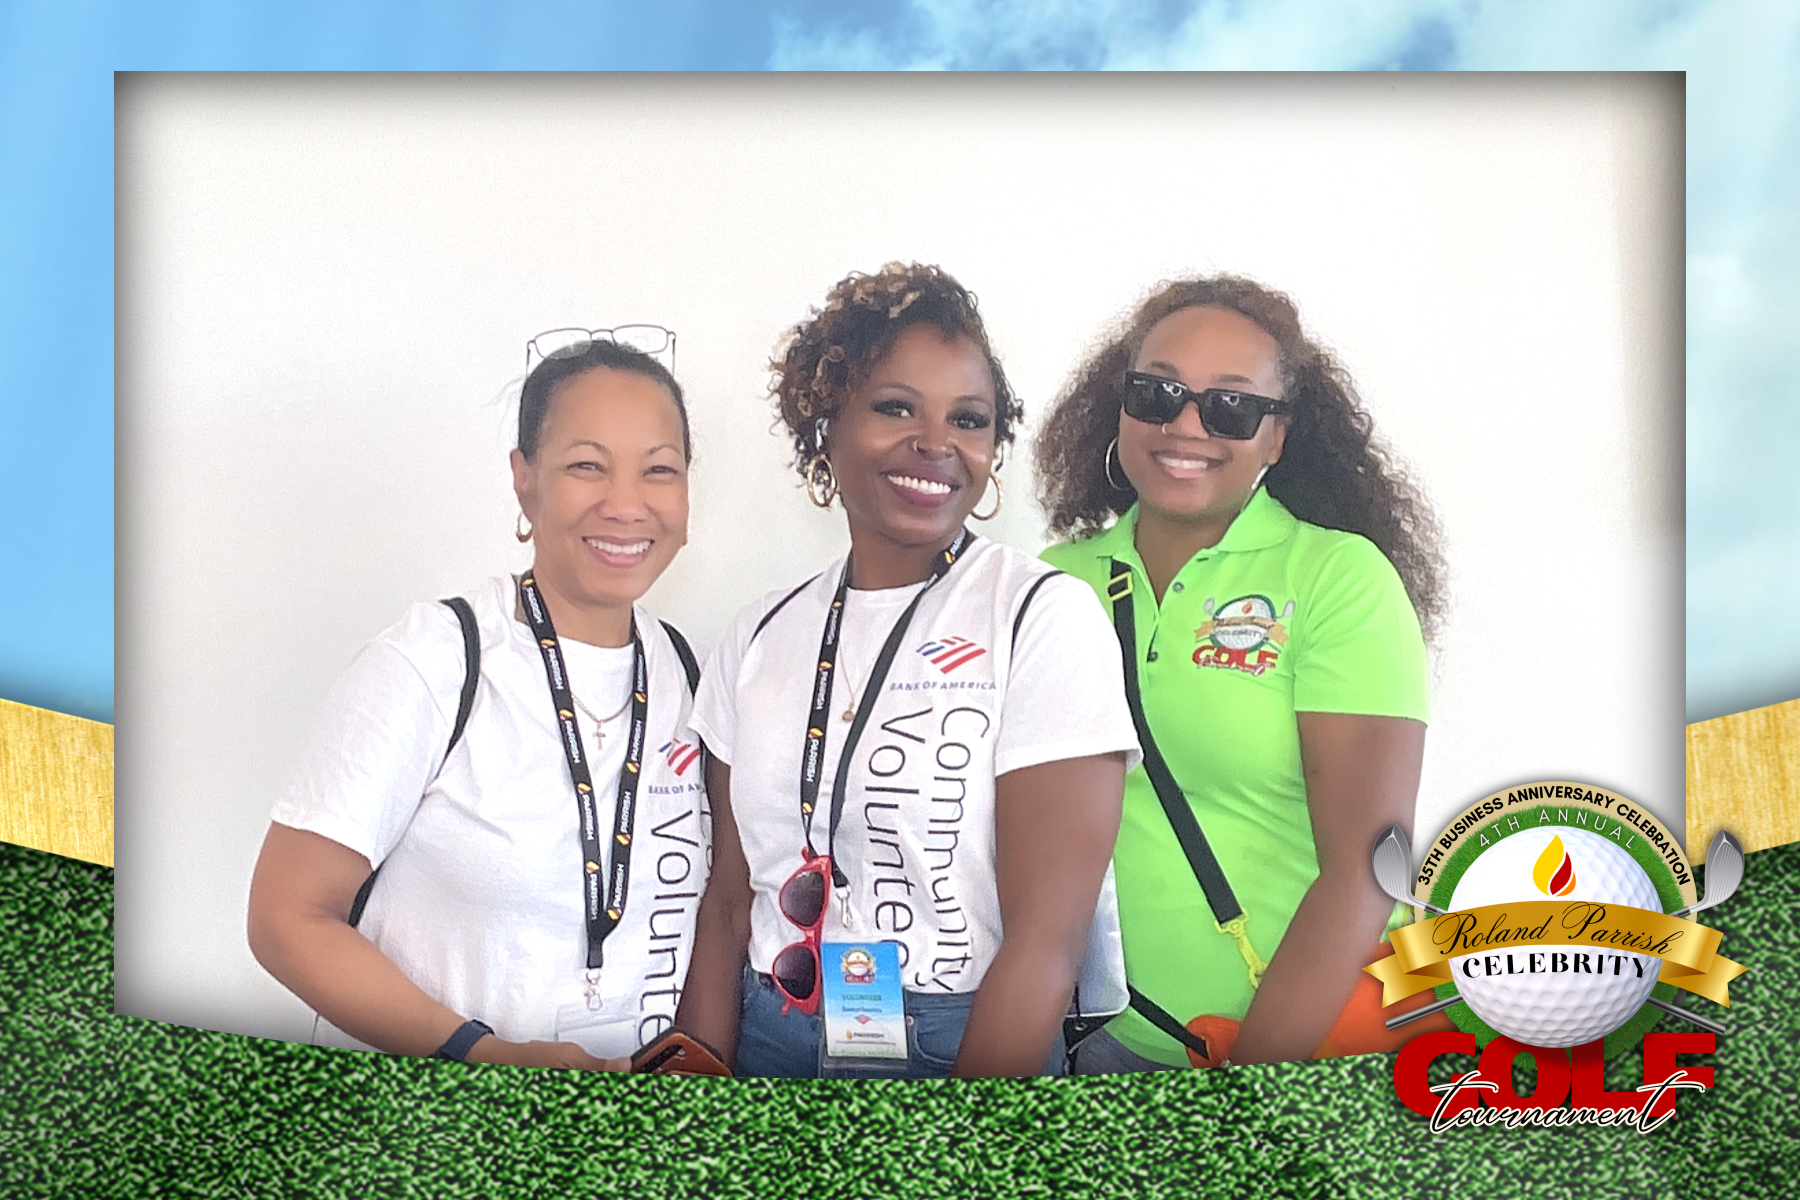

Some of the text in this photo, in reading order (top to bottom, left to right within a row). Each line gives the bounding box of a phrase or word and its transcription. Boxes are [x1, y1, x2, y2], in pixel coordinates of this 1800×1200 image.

[890, 681, 997, 691] BANK OF AMERICA
[1192, 645, 1278, 673] GOLF
[806, 739, 819, 782] PARRISH
[864, 707, 933, 969] Volunte
[915, 707, 990, 992] Community
[639, 809, 700, 1047] Volunte
